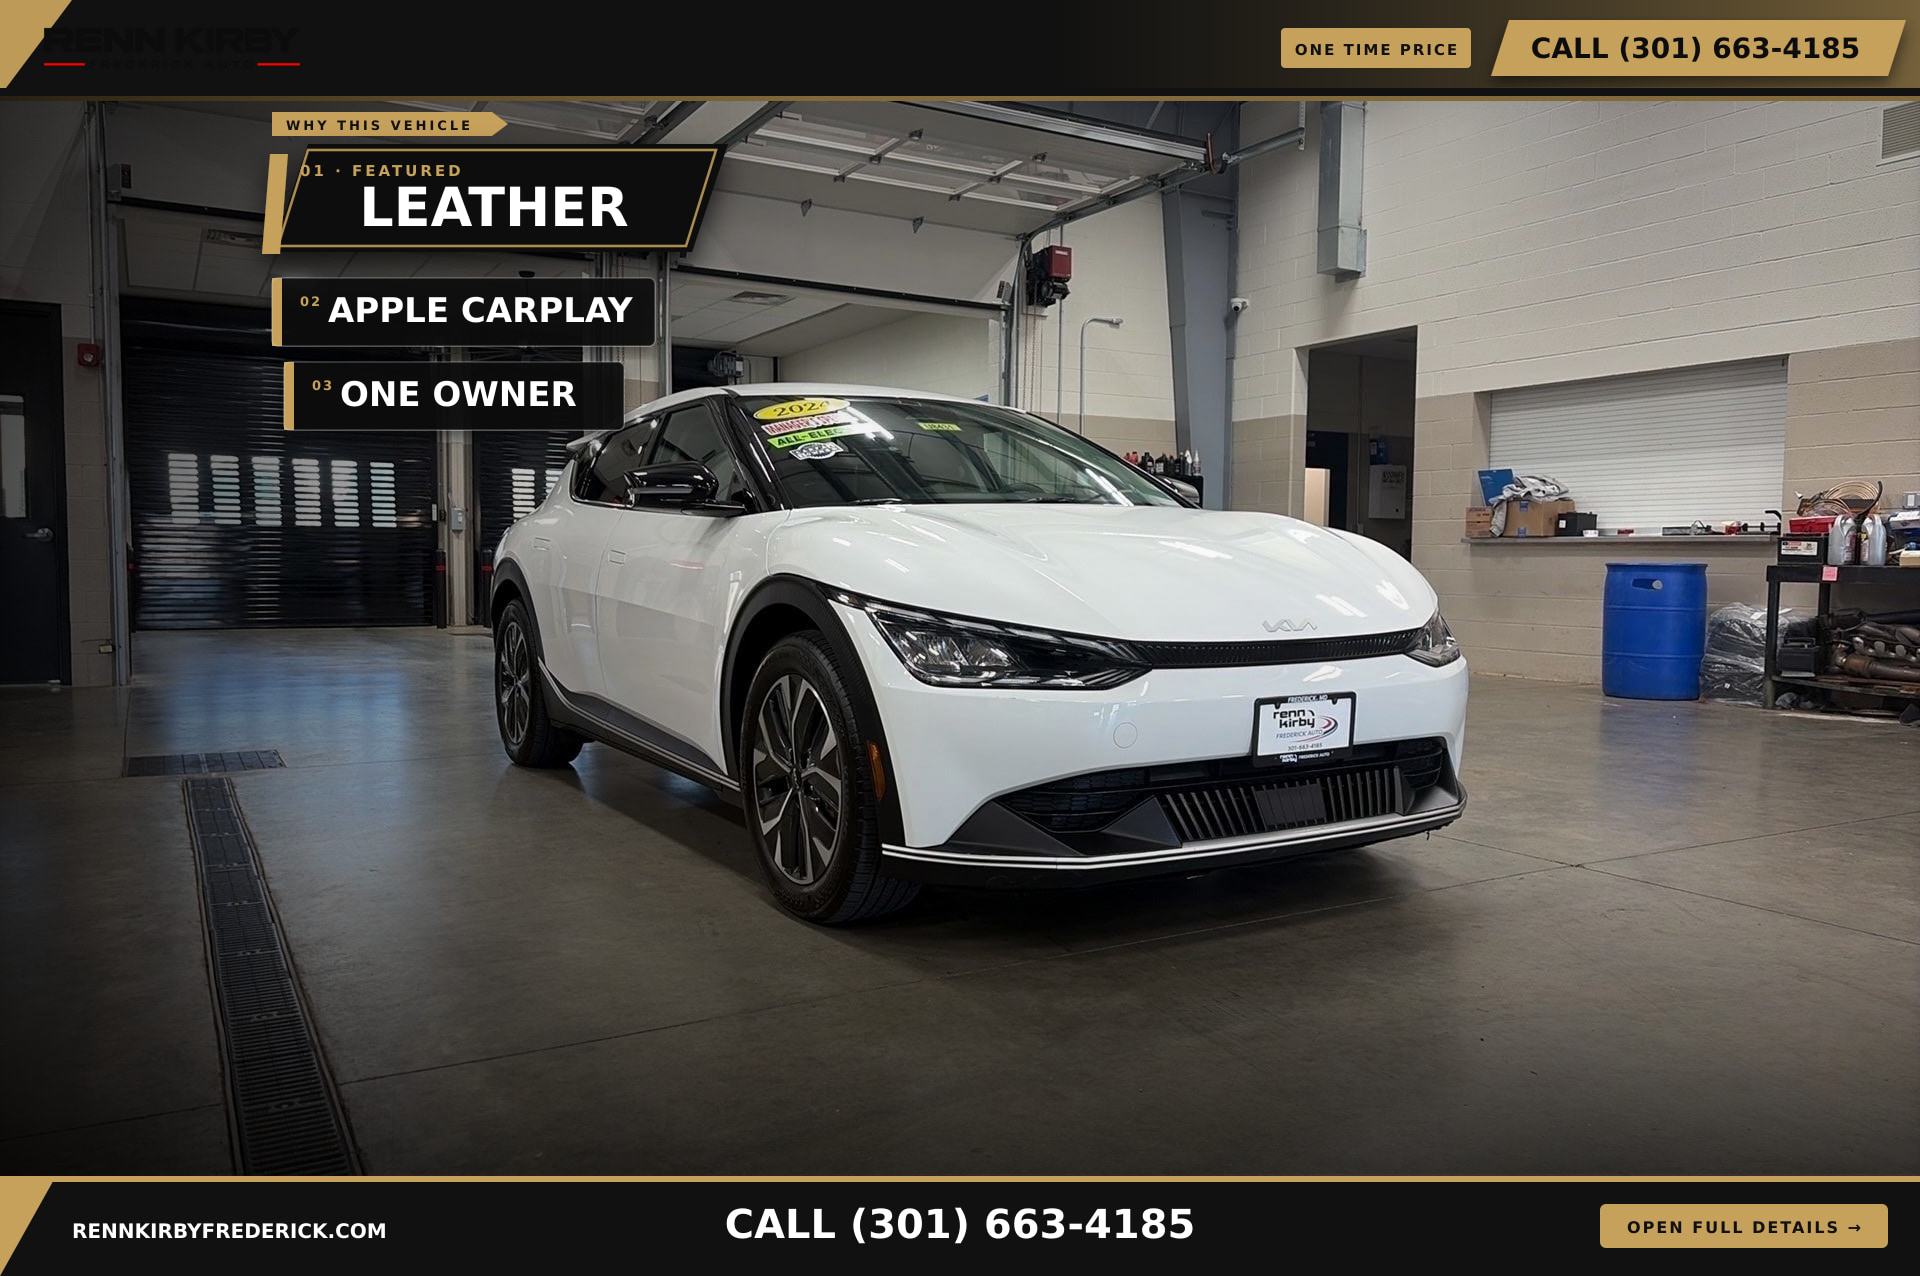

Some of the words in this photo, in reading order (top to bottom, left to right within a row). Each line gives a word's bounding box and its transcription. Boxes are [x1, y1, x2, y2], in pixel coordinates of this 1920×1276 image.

[1262, 619, 1318, 632] KIA
[1273, 709, 1306, 720] renn
[1279, 717, 1316, 729] kirby
[1276, 731, 1307, 740] FREDERICK
[1307, 729, 1323, 737] AUTO
